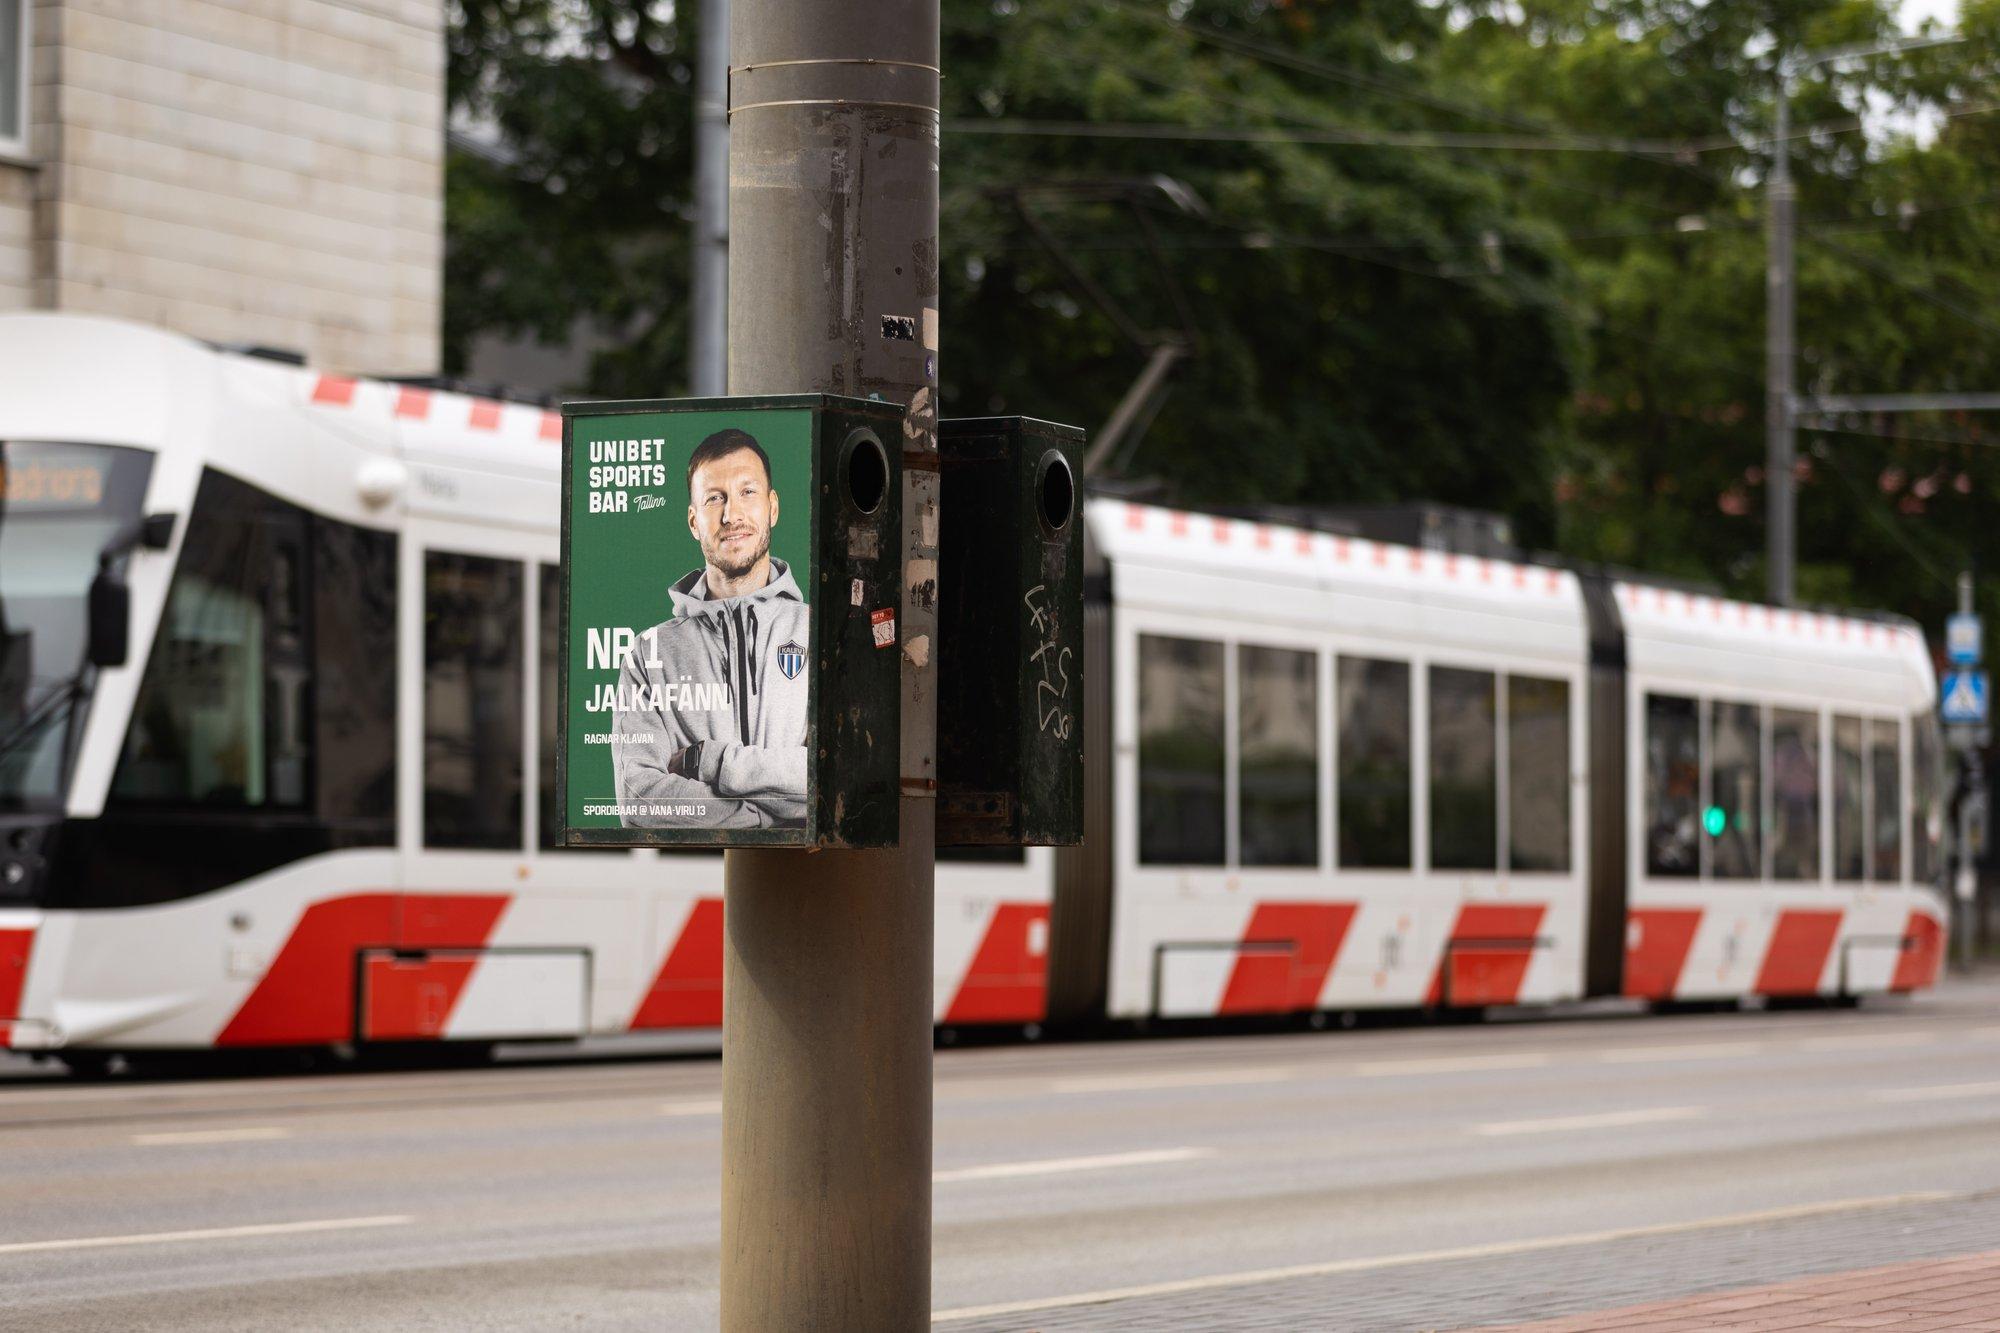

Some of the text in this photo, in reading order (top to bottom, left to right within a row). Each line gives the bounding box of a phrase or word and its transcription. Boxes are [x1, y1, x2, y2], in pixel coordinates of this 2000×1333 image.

[590, 439, 665, 463] UNIBET
[589, 464, 666, 488] SPORTS
[589, 491, 666, 513] BAR Tallinn
[587, 627, 664, 670] NR 1
[585, 675, 729, 712] JALKAFÄNN
[584, 733, 654, 744] RAGNAR KLAVAN
[583, 805, 706, 816] SPORDIBAAR @ VANA-VIRU 13
